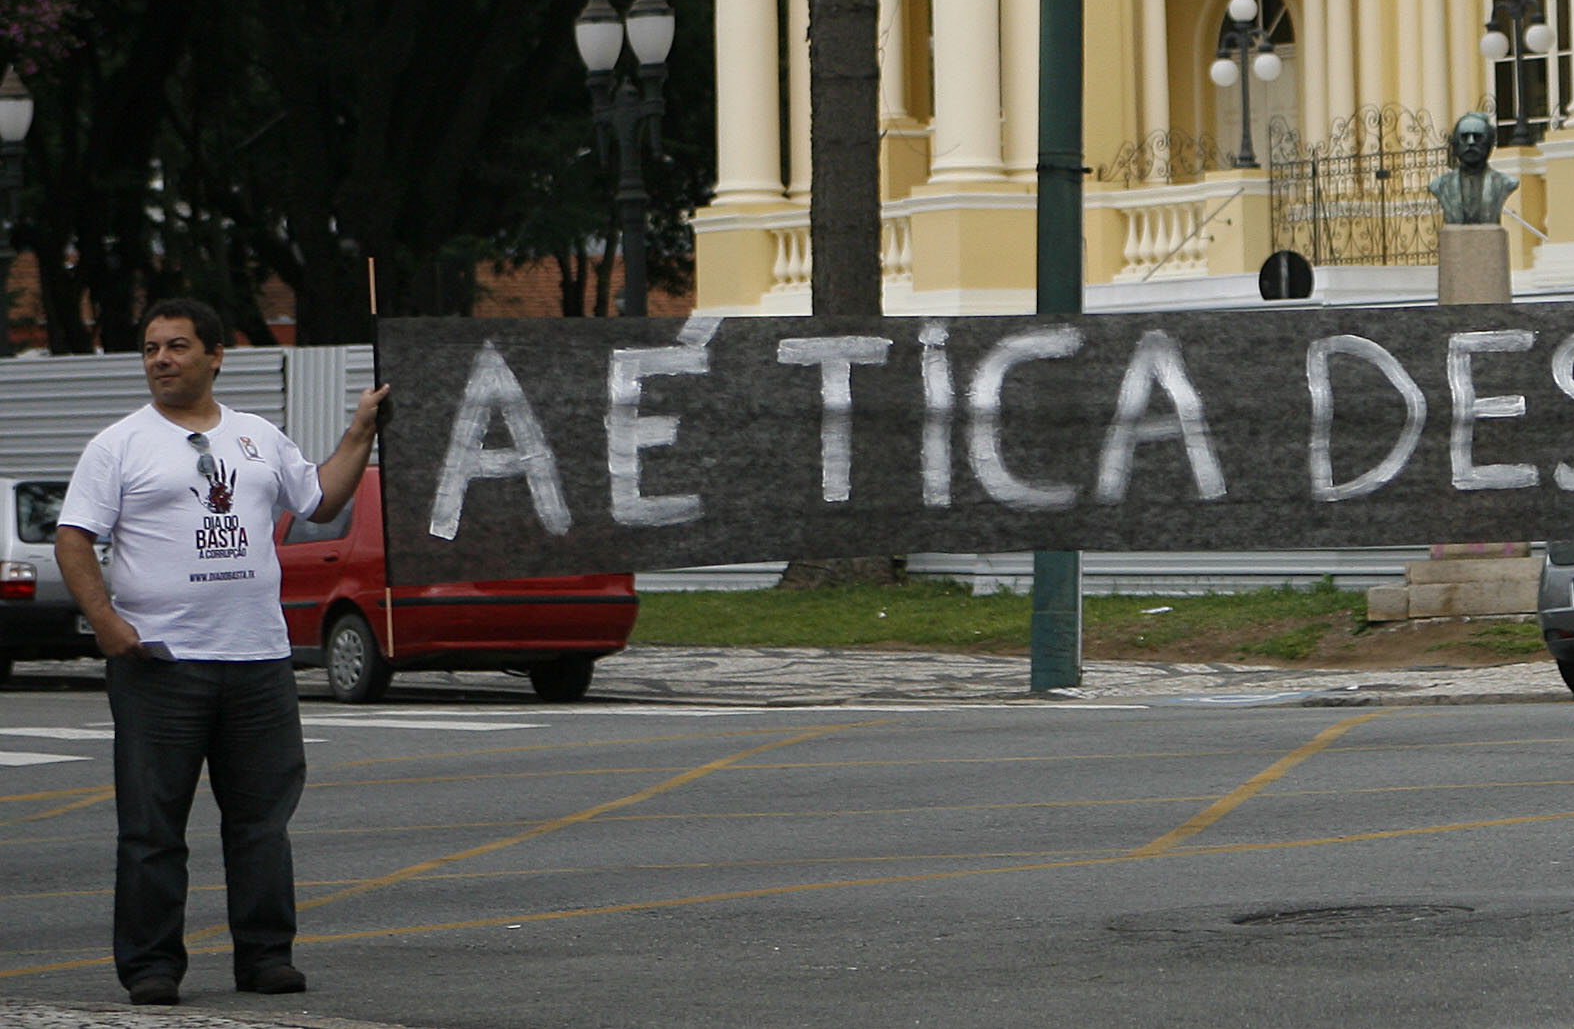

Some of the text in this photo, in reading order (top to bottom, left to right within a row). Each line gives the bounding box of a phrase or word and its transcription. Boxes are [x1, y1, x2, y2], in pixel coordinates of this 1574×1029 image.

[428, 338, 572, 540] A
[604, 312, 1229, 528] ÉTICA
[203, 515, 239, 531] DIA DO
[196, 527, 248, 550] BASTA
